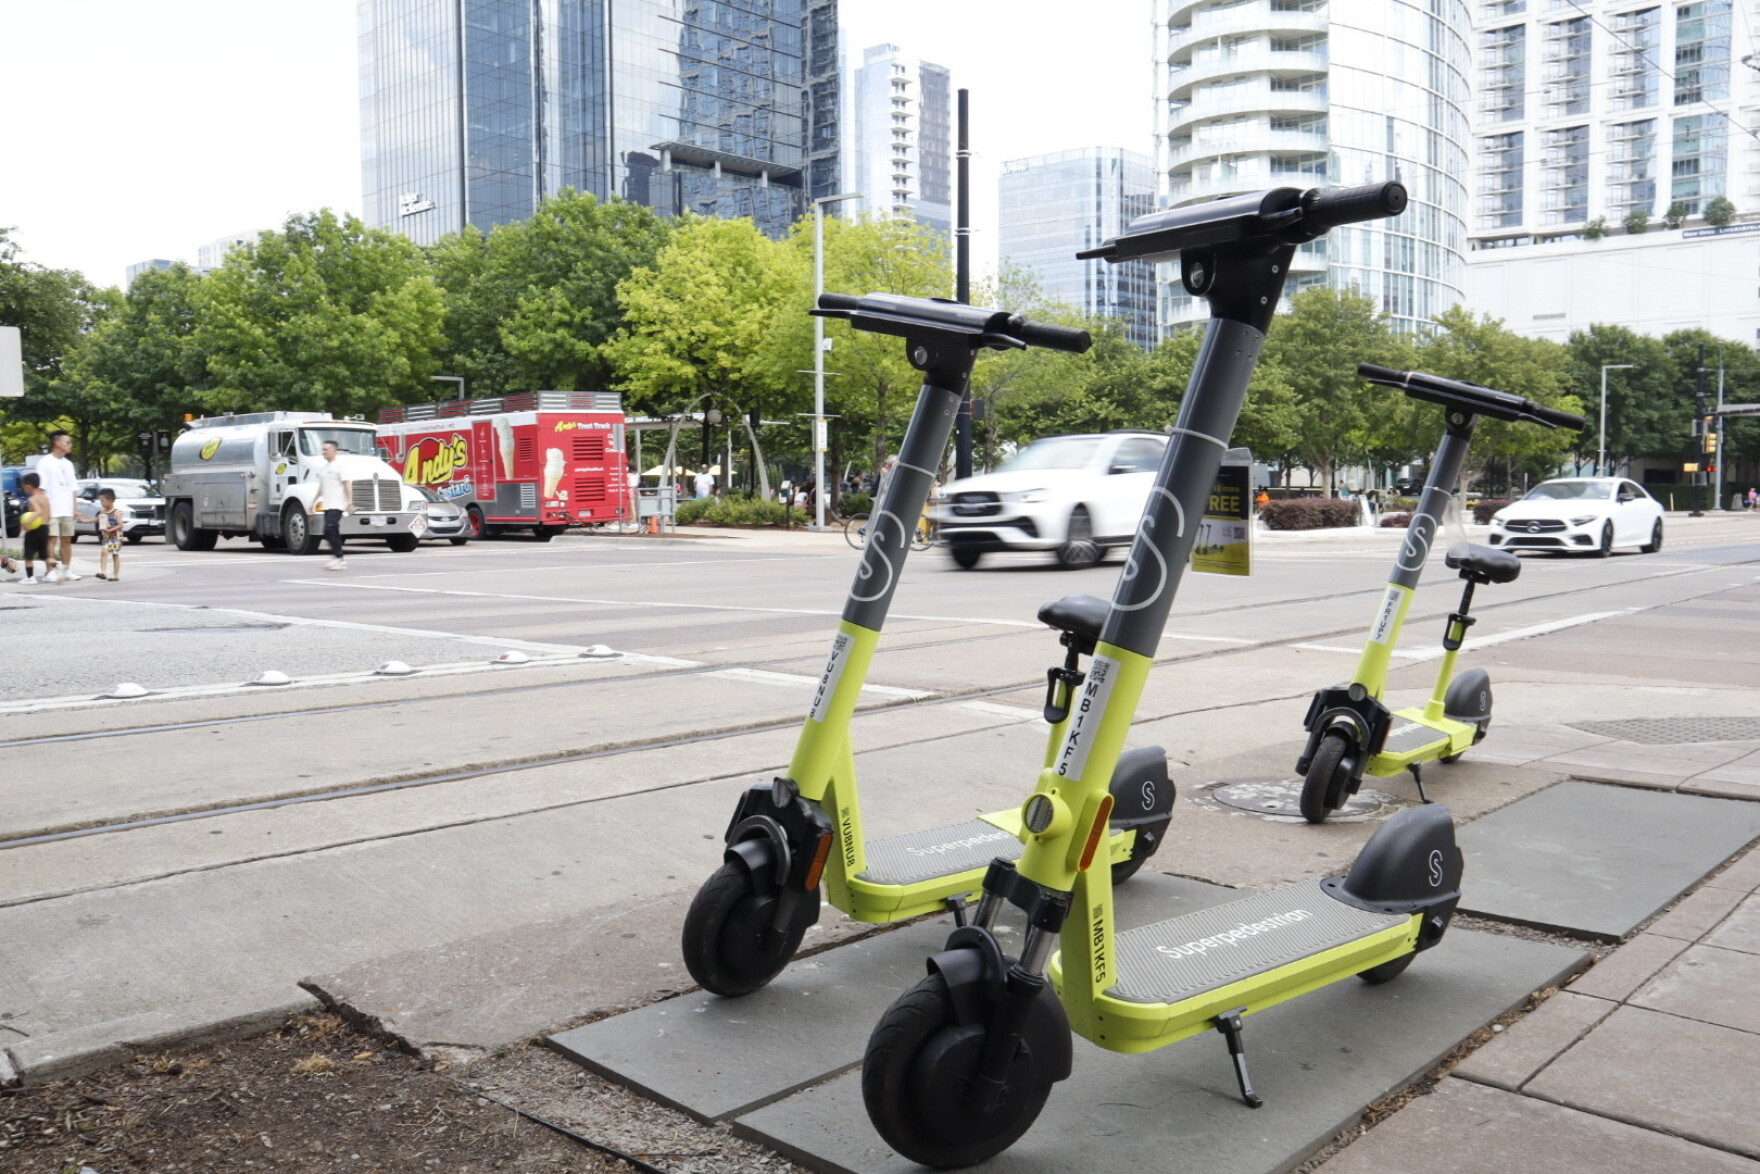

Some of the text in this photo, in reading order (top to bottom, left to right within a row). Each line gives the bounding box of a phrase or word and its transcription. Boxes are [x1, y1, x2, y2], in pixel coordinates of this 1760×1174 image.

[403, 433, 467, 485] Andy's
[1208, 495, 1241, 512] REE
[809, 651, 839, 718] VU8NU8
[1058, 681, 1098, 776] MB1KF5
[843, 816, 856, 867] VU8NU8
[906, 831, 1011, 857] Superpedes
[1093, 918, 1106, 984] MB1KF5
[1156, 906, 1314, 960] Superpedestrian
